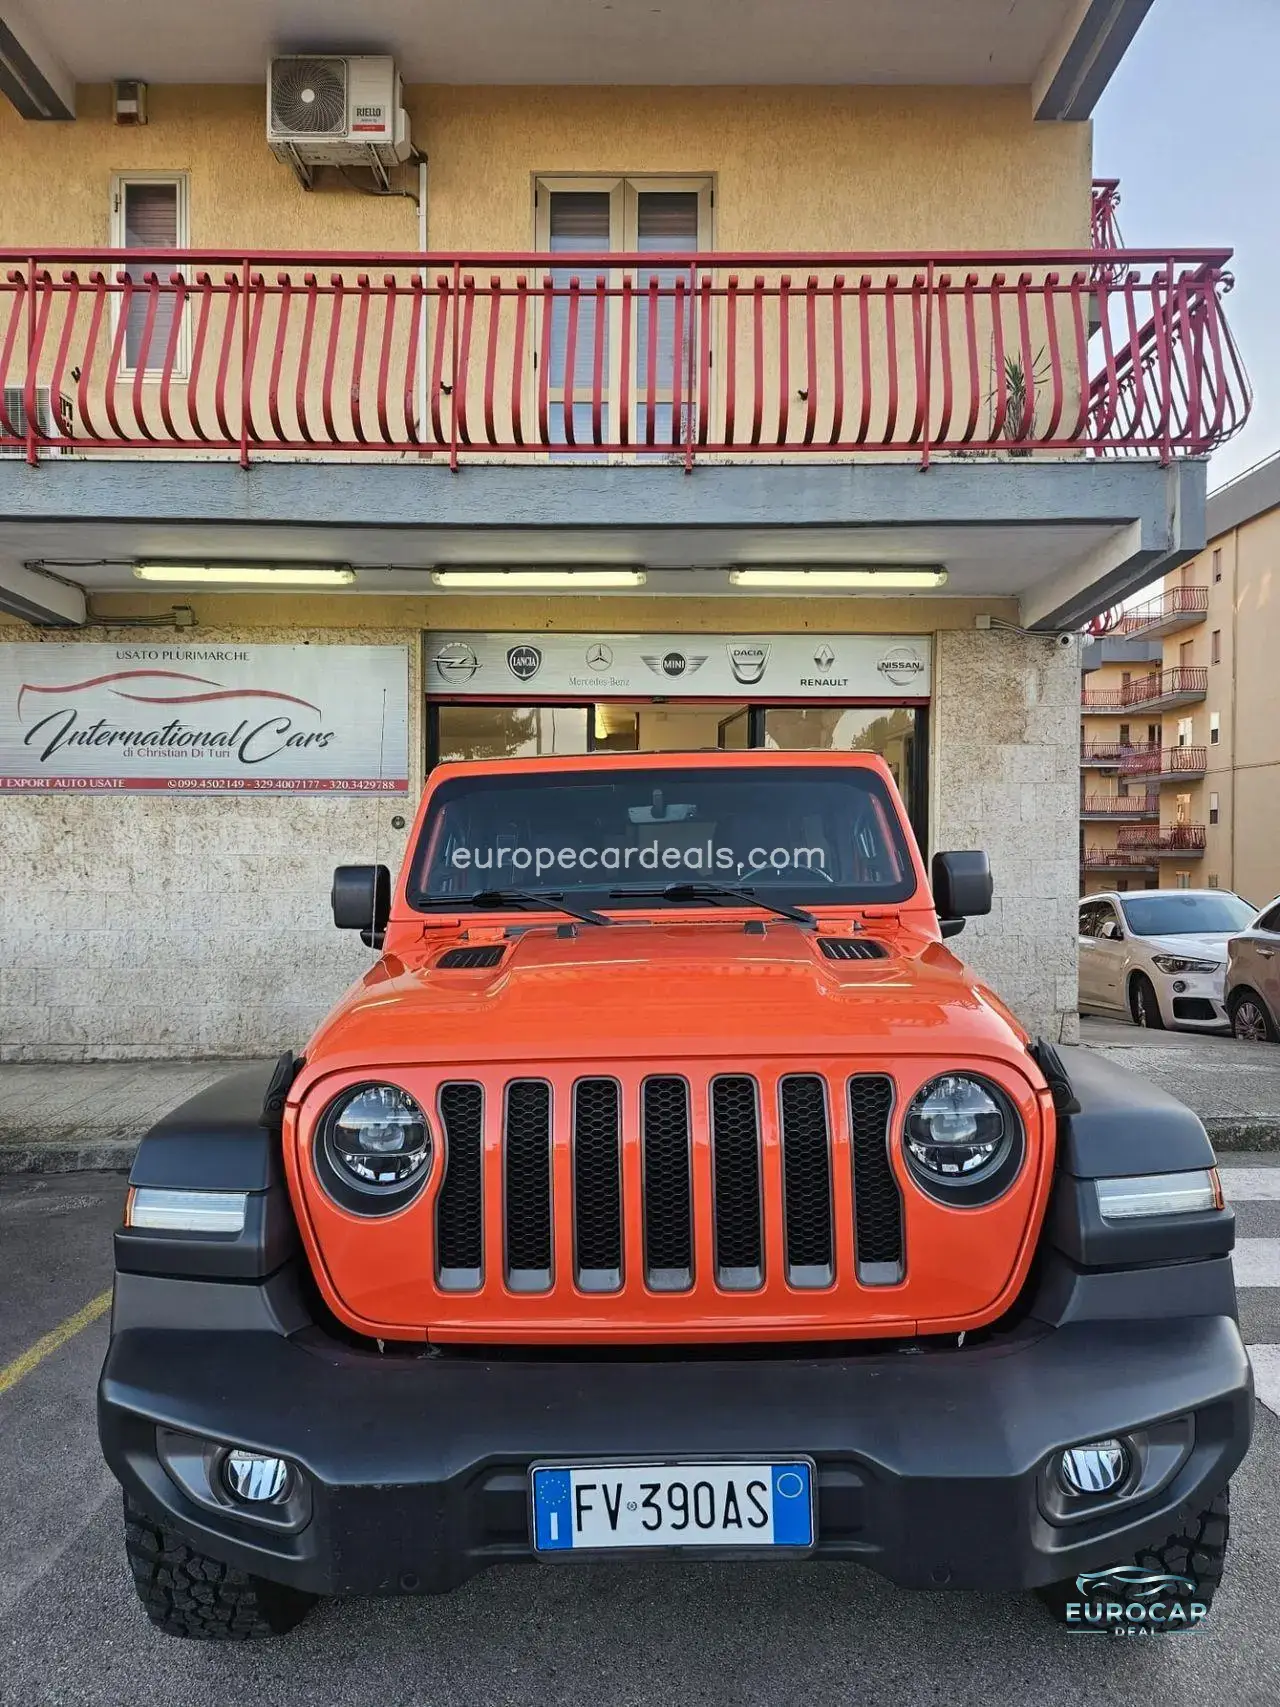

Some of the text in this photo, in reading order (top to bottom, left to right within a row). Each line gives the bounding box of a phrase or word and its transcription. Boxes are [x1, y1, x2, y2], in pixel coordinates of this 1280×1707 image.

[356, 107, 381, 117] RIELLO
[116, 650, 250, 661] USATO PLURIMARCHE
[733, 649, 764, 657] DACIA
[512, 656, 536, 667] LANCIA
[663, 659, 685, 669] MINI
[881, 661, 920, 669] NISSAN
[569, 676, 630, 687] Mercedes-Benz
[800, 678, 849, 687] RENAULT
[23, 708, 337, 764] International Cars
[123, 747, 230, 758] di Christian Di Turi
[7, 778, 51, 788] EXPORT
[54, 779, 87, 788] AUTO
[90, 779, 125, 788] USATE
[575, 1480, 769, 1532] FV 390AS
